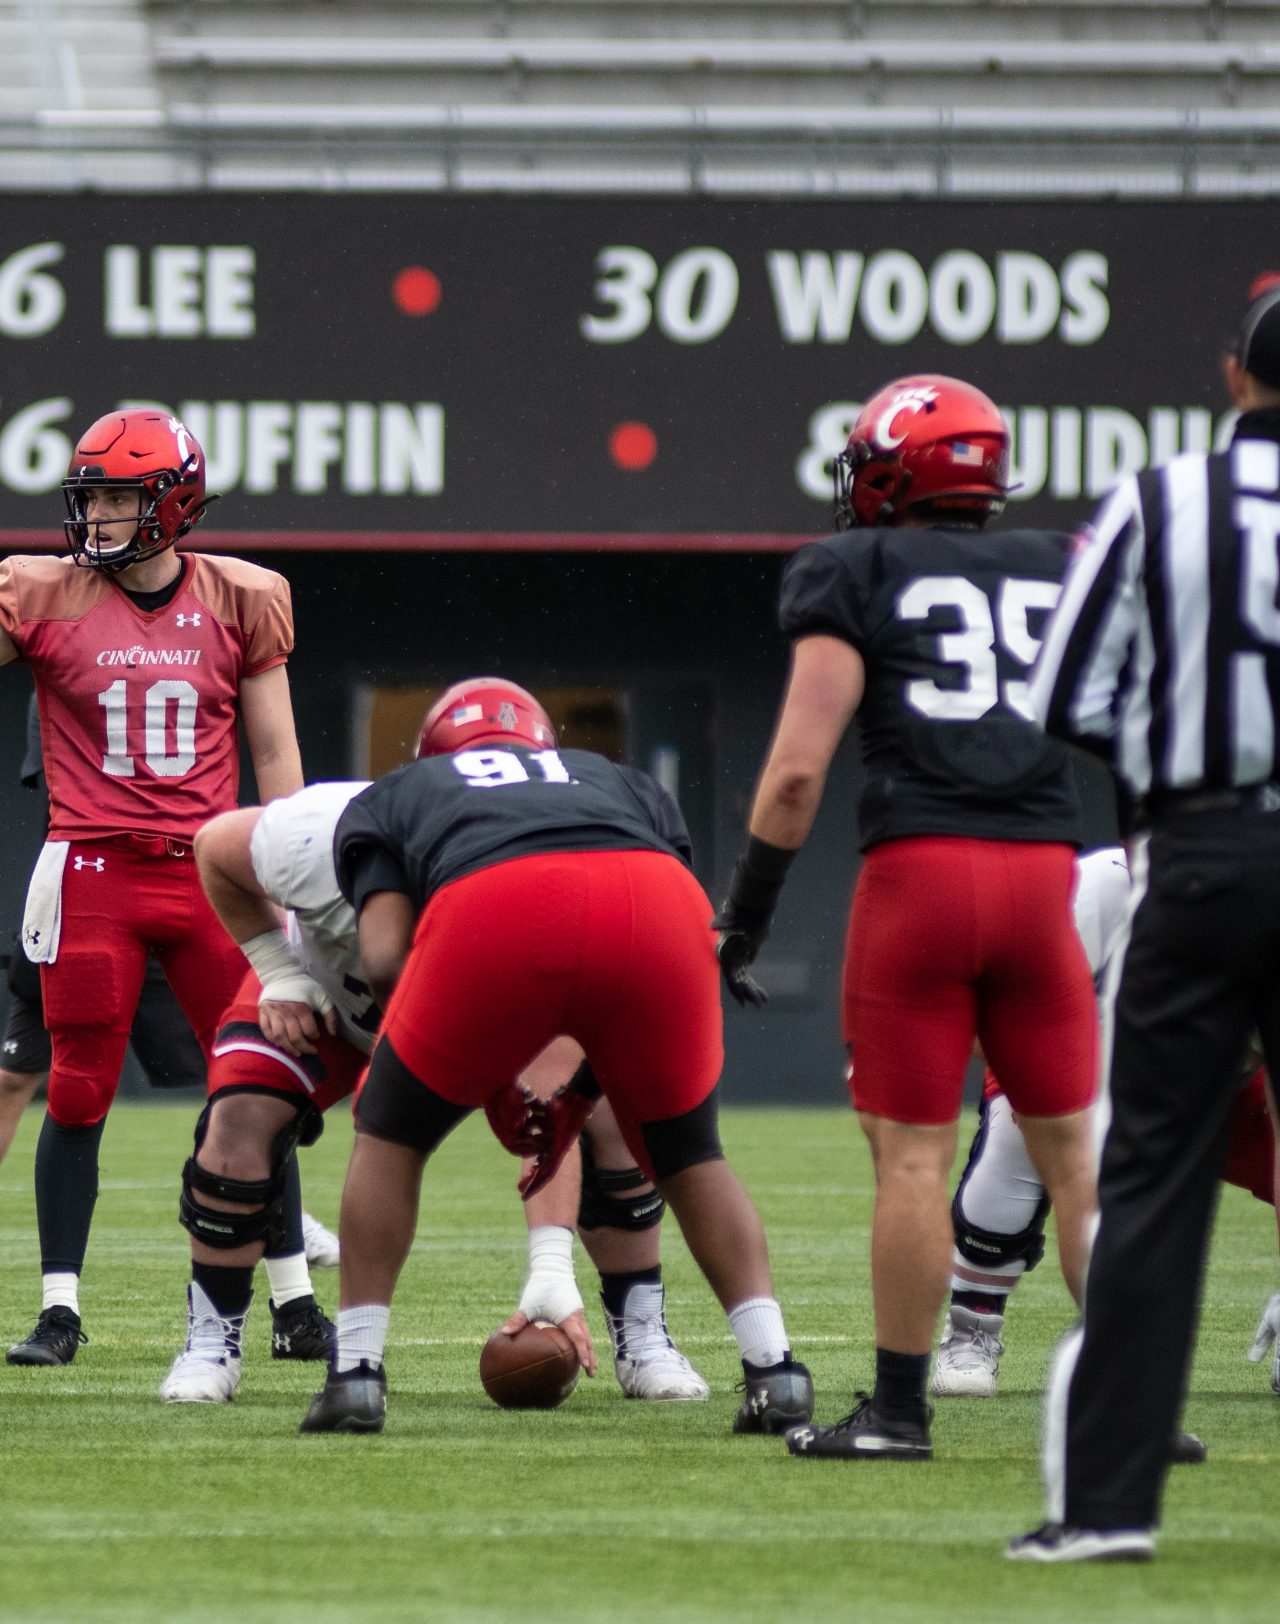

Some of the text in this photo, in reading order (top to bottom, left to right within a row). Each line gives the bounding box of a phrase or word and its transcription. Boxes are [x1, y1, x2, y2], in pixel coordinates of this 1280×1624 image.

[105, 246, 255, 337] LEE
[580, 246, 1111, 345] 30 WOODS
[120, 401, 442, 493] UFFIN
[96, 646, 201, 666] CINCINNATI
[98, 680, 198, 776] 10
[453, 750, 570, 787] 91
